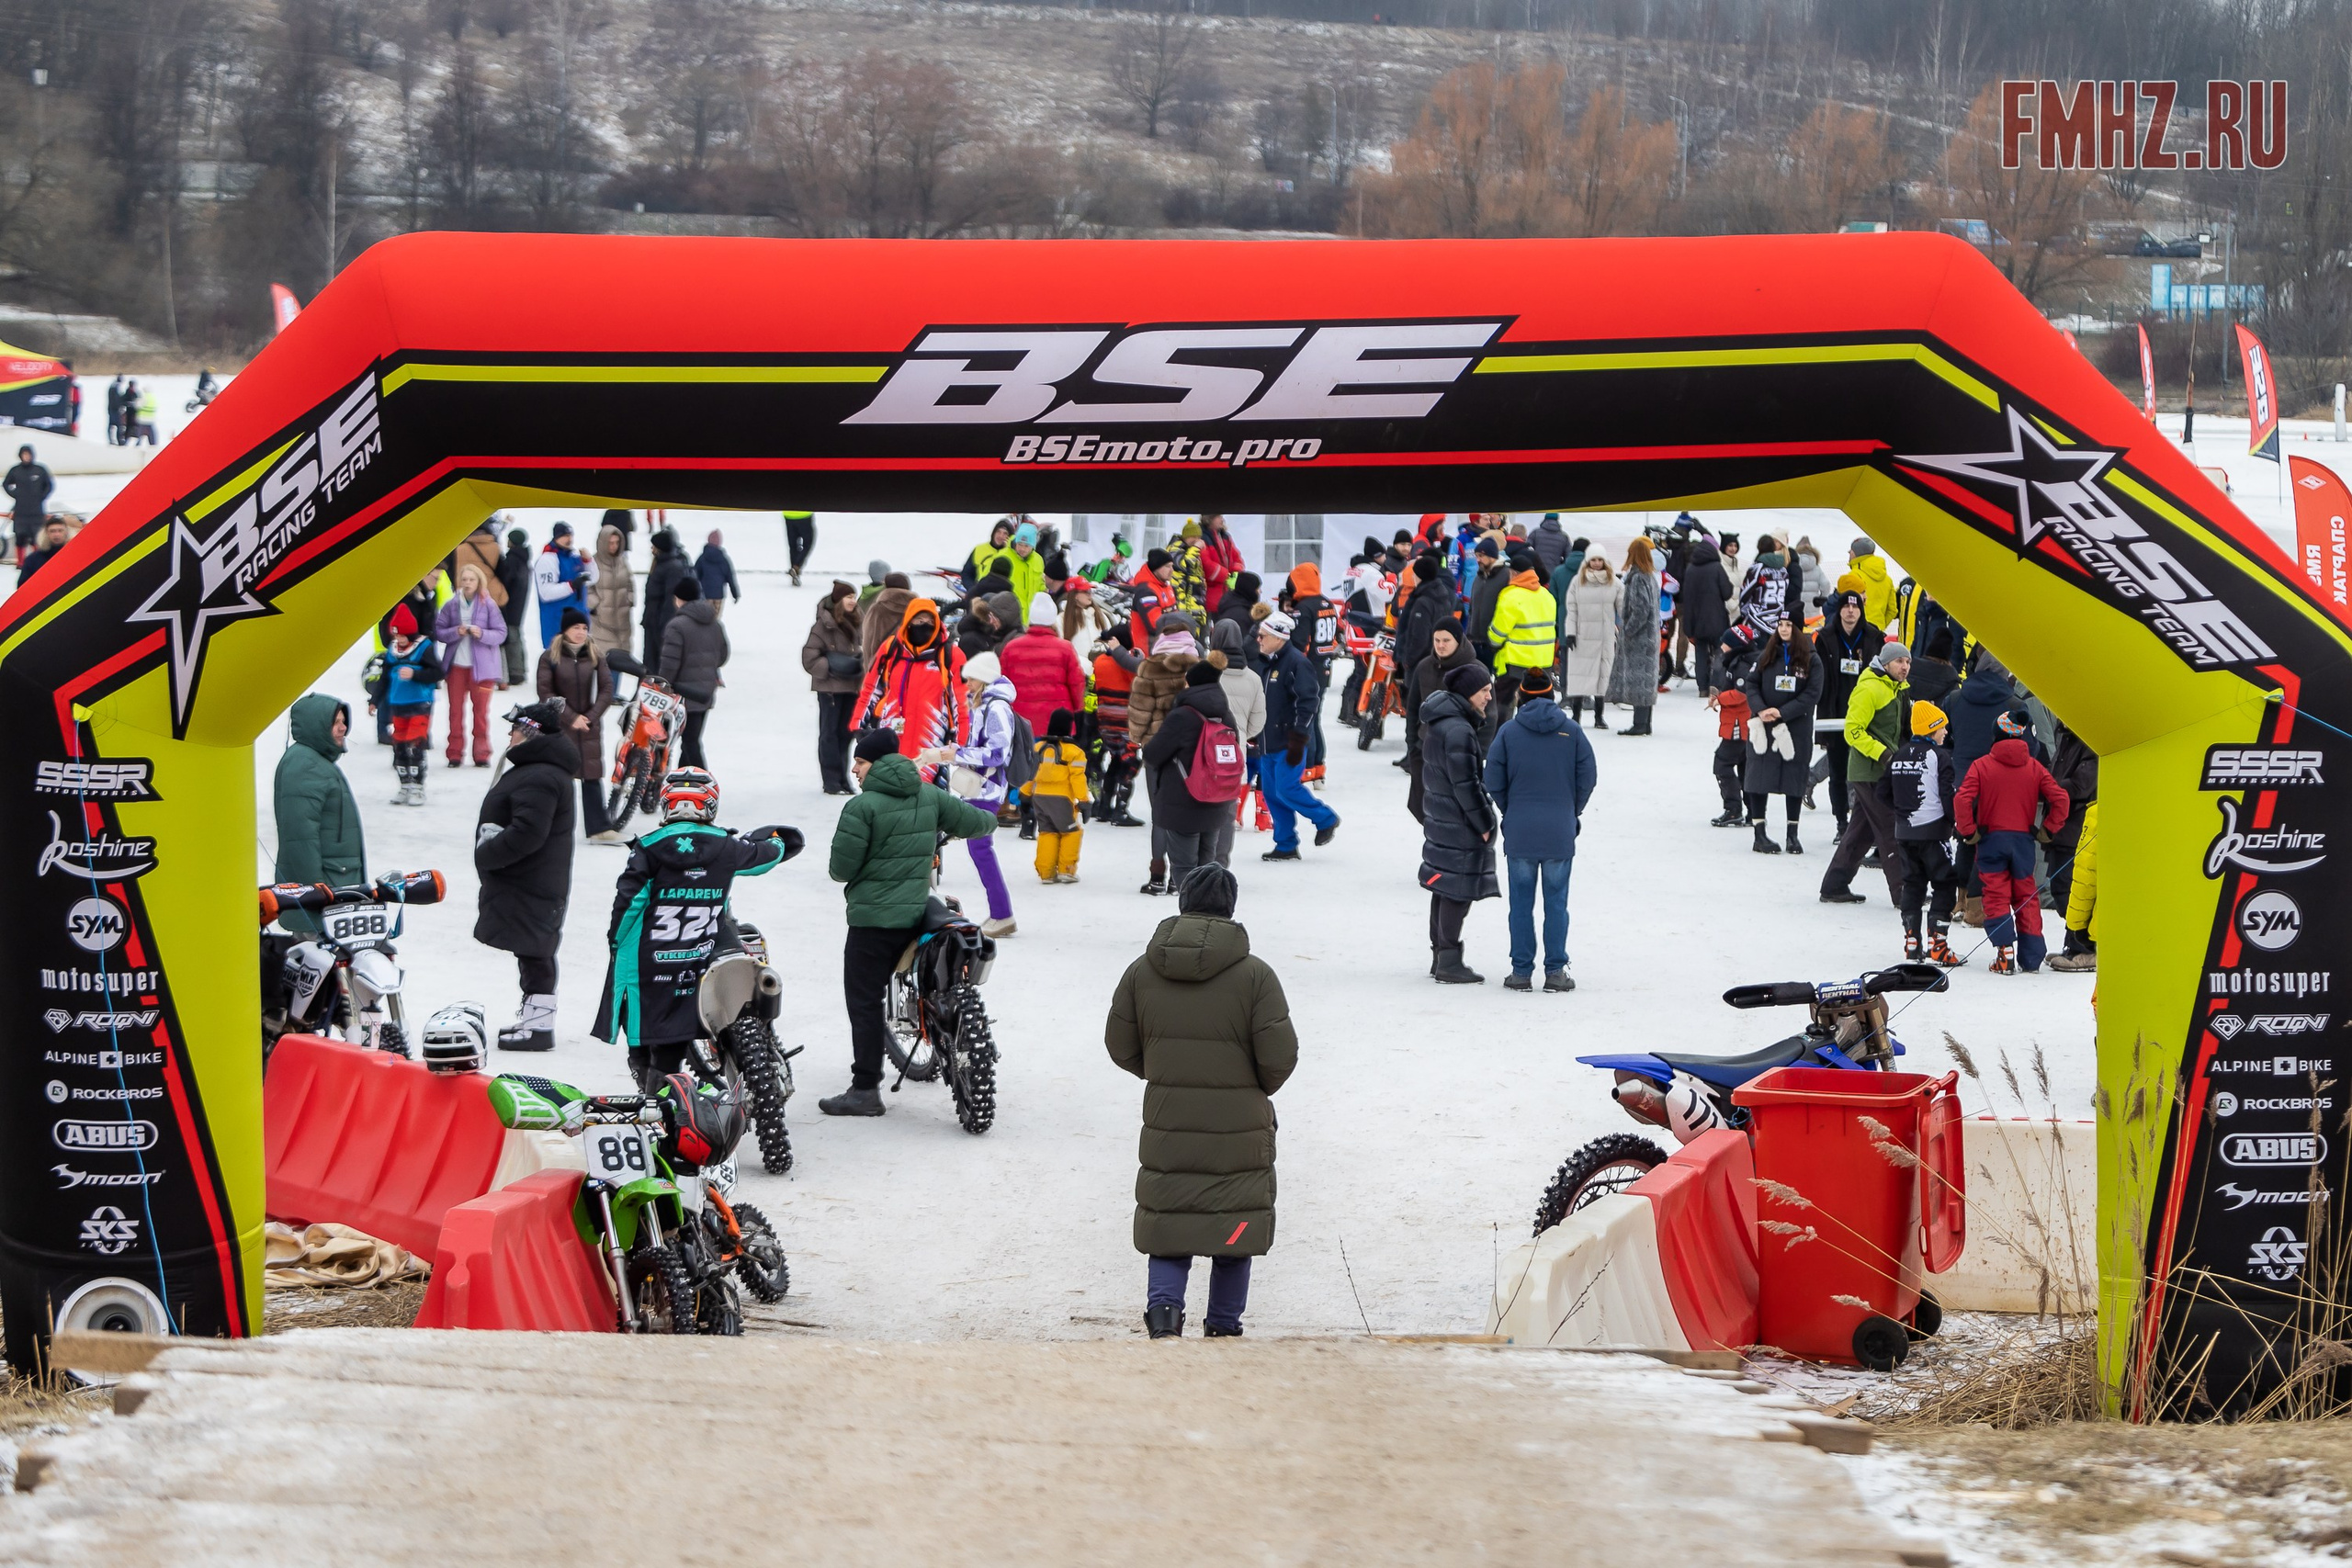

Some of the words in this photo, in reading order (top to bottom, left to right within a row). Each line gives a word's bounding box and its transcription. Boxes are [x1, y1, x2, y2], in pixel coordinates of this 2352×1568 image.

[839, 323, 1503, 424] BSE
[1004, 435, 1321, 466] BSEmoto.pro
[199, 371, 380, 604] BSE
[235, 500, 316, 593] RACING
[322, 432, 382, 503] TEAM
[2031, 480, 2278, 663] BSE
[2042, 516, 2145, 599] RACING
[2141, 603, 2219, 665] TEAM
[643, 692, 668, 711] 789
[37, 761, 150, 795] SSSR
[2209, 750, 2325, 784] SSSR
[36, 786, 138, 795] MOTORSPORTS
[67, 914, 124, 940] SYM
[334, 915, 387, 939] 888
[2243, 910, 2300, 937] SYM
[41, 967, 158, 997] motosuper
[2209, 968, 2330, 998] motosuper
[45, 1050, 98, 1065] ALPINE
[125, 1052, 162, 1065] BIKE
[2211, 1060, 2271, 1072] ALPINE
[2300, 1060, 2332, 1071] BIKE
[73, 1088, 164, 1100] ROCKBROS
[2244, 1098, 2332, 1110] ROCKBROS
[65, 1124, 146, 1145] ABUS
[598, 1135, 644, 1172] 88
[2233, 1138, 2316, 1160] ABUS
[84, 1173, 162, 1185] moon
[80, 1220, 140, 1239] SKS
[2247, 1243, 2309, 1264] SKS
